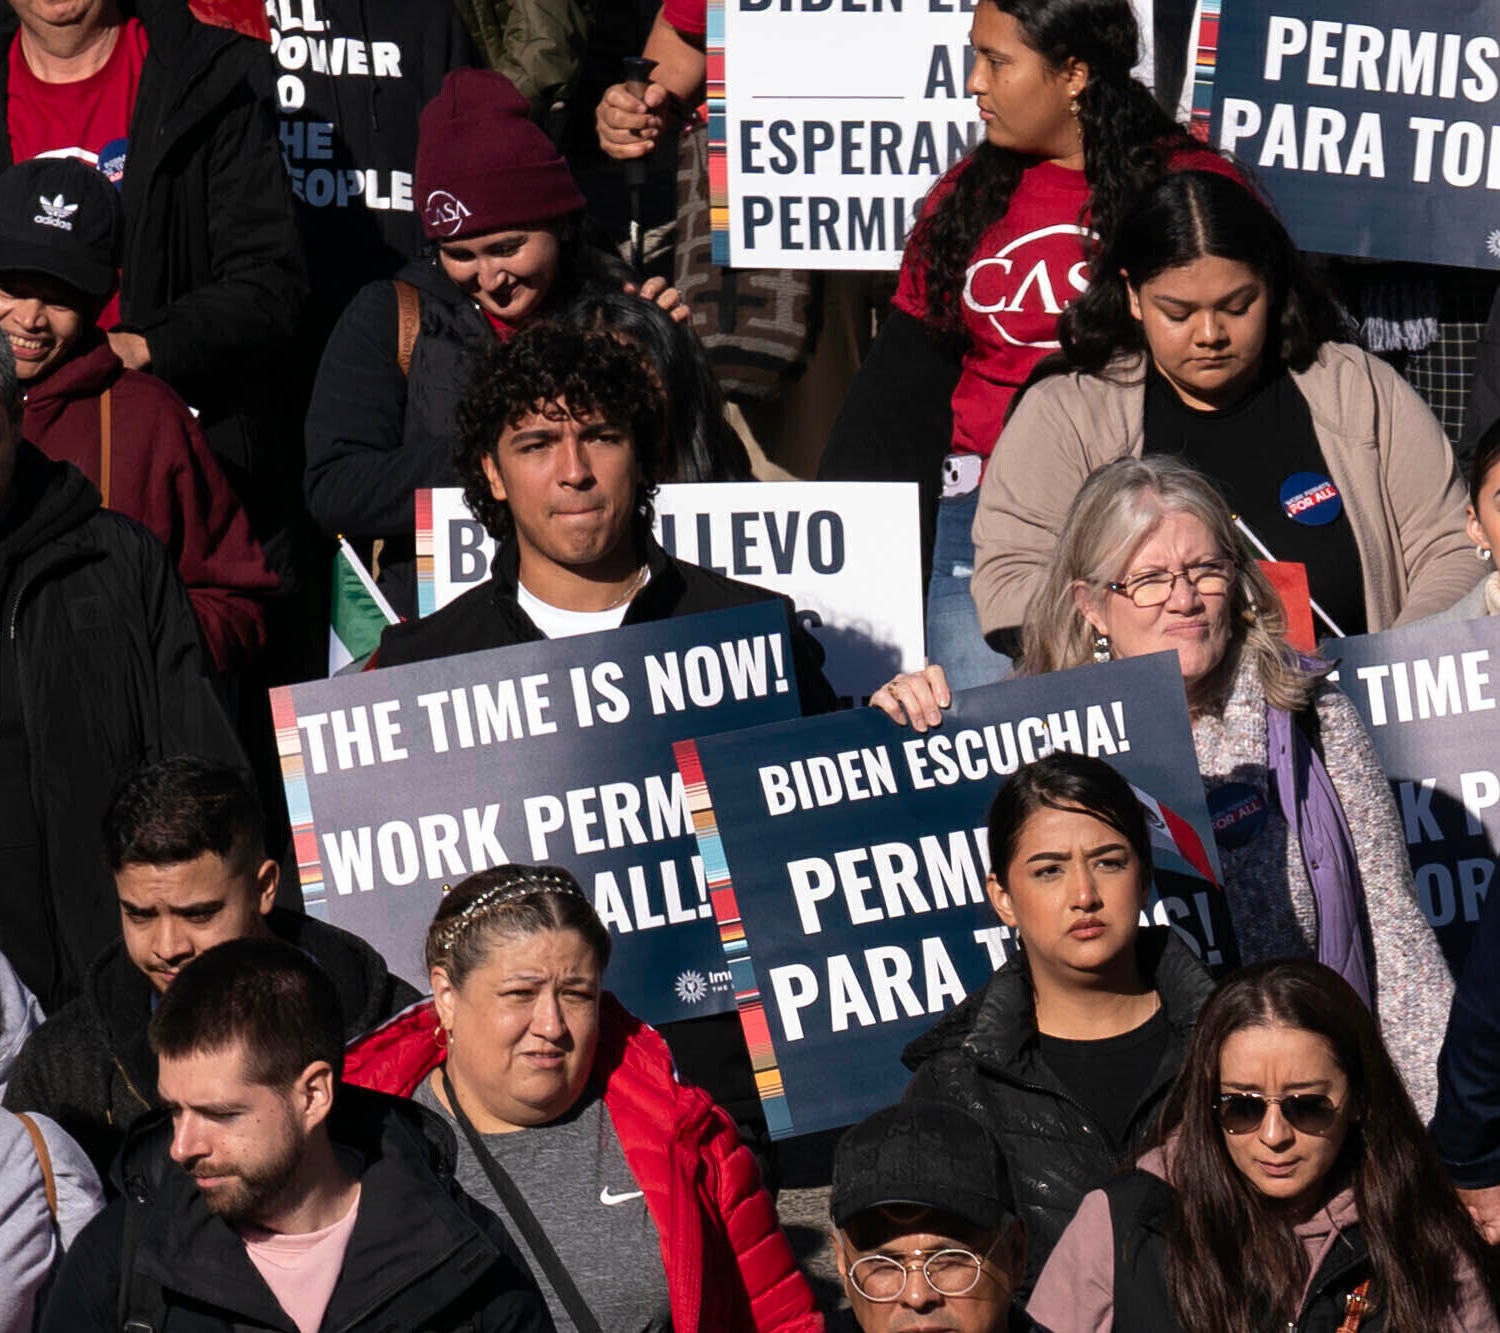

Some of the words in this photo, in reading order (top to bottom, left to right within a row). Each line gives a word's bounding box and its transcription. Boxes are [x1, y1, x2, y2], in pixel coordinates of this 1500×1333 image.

[739, 120, 985, 177] ESPERAN
[1220, 98, 1385, 178] PARA
[33, 212, 73, 232] adidas
[741, 195, 908, 251] PERMI
[1288, 496, 1314, 515] FOR
[1315, 487, 1336, 504] ALL
[298, 710, 408, 776] THE
[418, 680, 557, 754] TIME
[568, 664, 626, 731] IS
[648, 632, 790, 720] NOW!
[1358, 647, 1497, 726] TIME
[758, 741, 897, 817] BIDEN
[904, 700, 1131, 793] ESCUCHA!
[323, 808, 509, 896] WORK
[524, 769, 696, 865] PERM
[769, 943, 968, 1043] PARA
